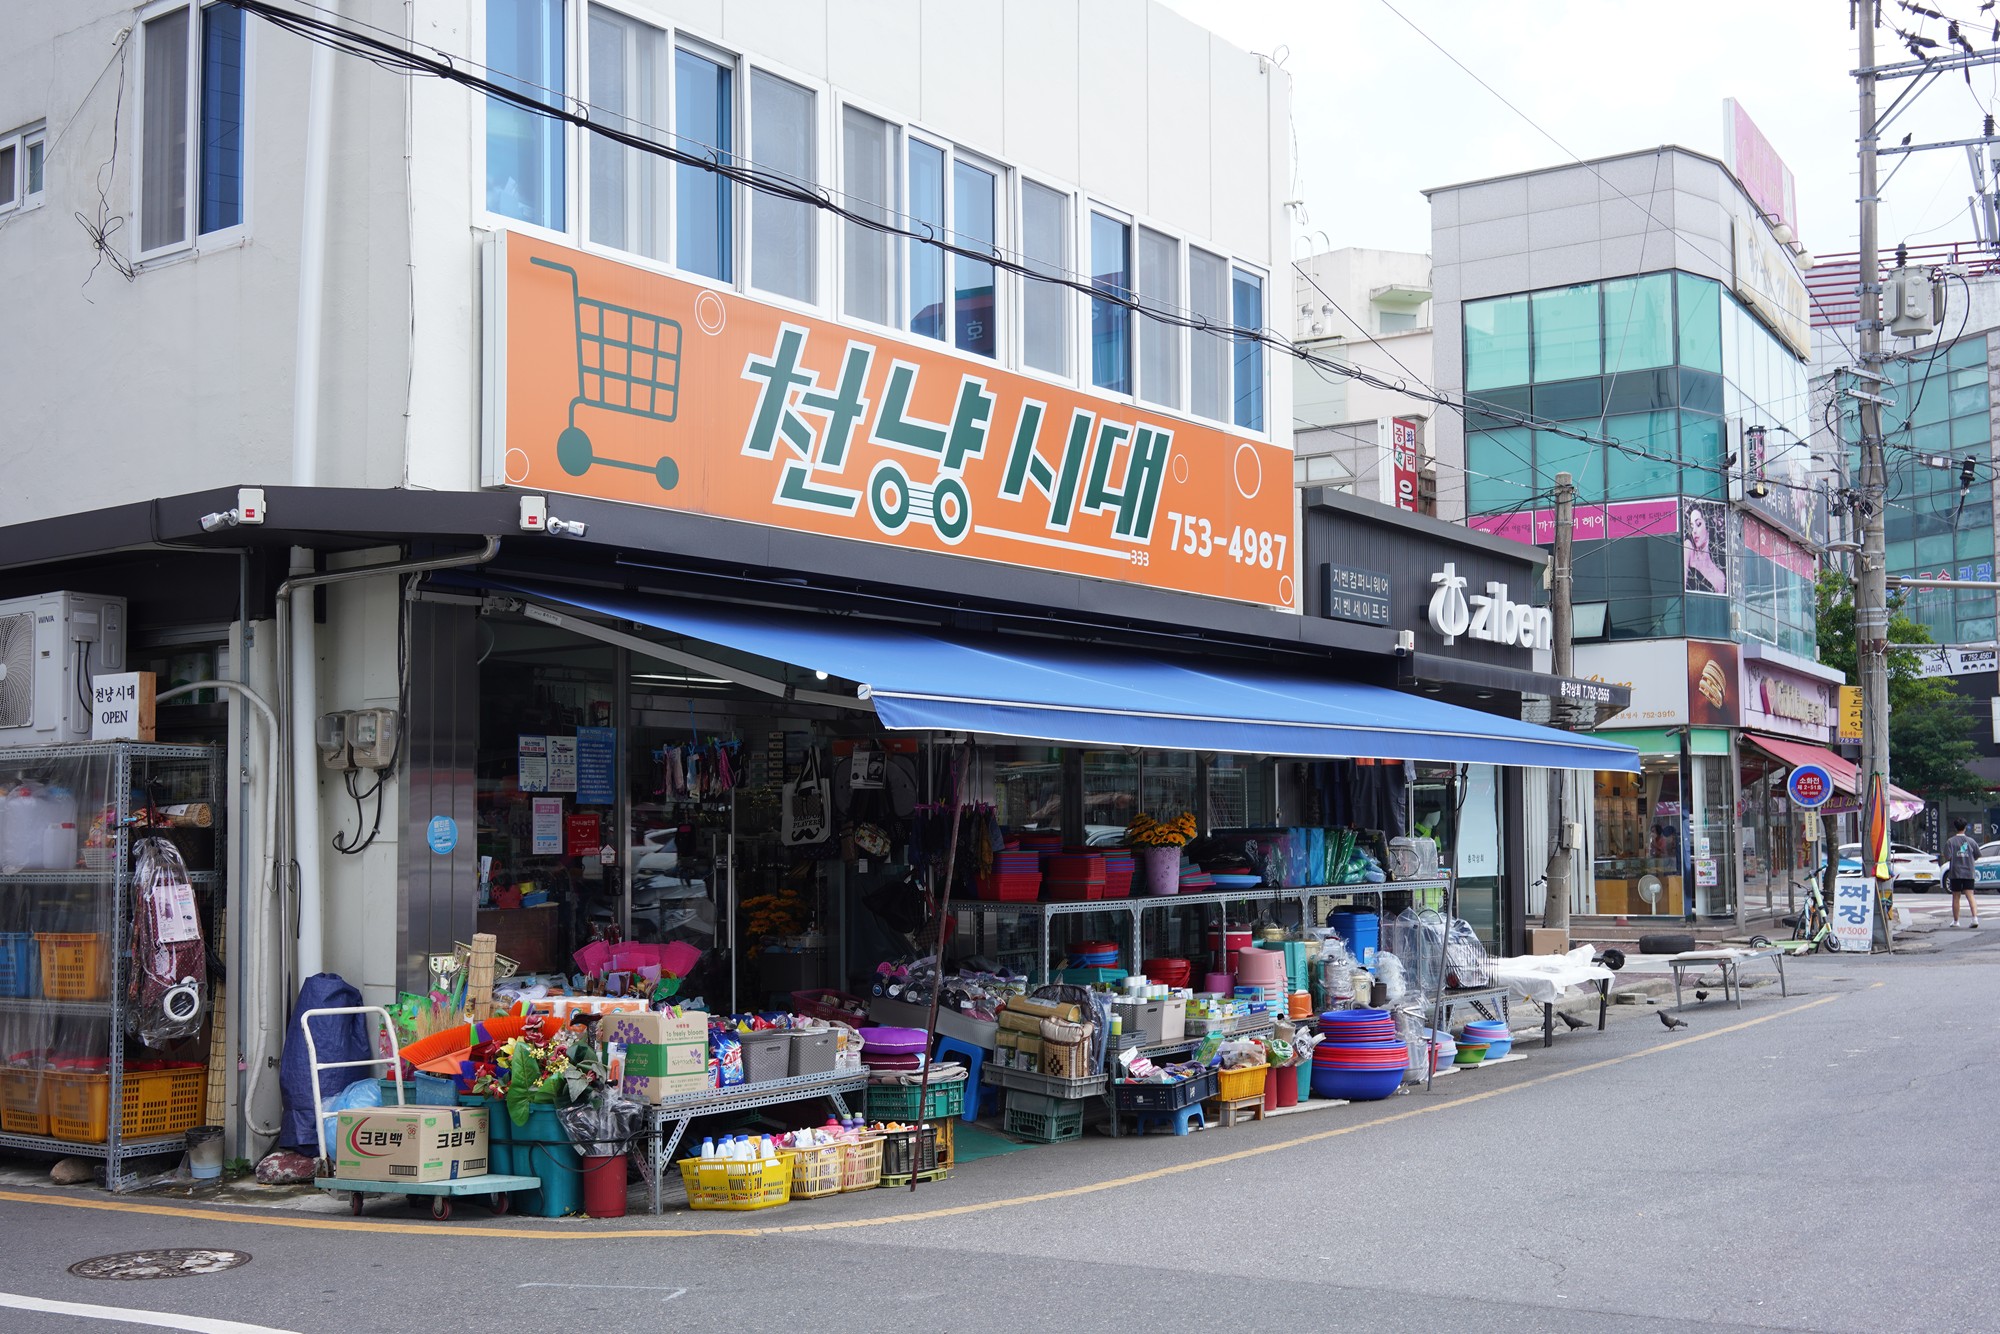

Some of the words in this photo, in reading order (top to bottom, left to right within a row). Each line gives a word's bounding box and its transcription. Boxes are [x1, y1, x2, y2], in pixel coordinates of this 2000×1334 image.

[1582, 515, 1604, 530] 헤어
[1168, 511, 1287, 571] 753-4987
[1333, 568, 1389, 595] 지벤컴퍼니웨어
[1333, 597, 1389, 623] 지벤세이프티
[1469, 581, 1553, 650] ziben
[1925, 664, 1943, 673] HAIR
[95, 684, 135, 703] 천냥시대
[101, 710, 128, 724] OPEN
[1799, 777, 1820, 785] 소화전
[1838, 884, 1871, 925] 짜장
[359, 1131, 402, 1147] 크린백
[437, 1130, 476, 1149] 크린백
